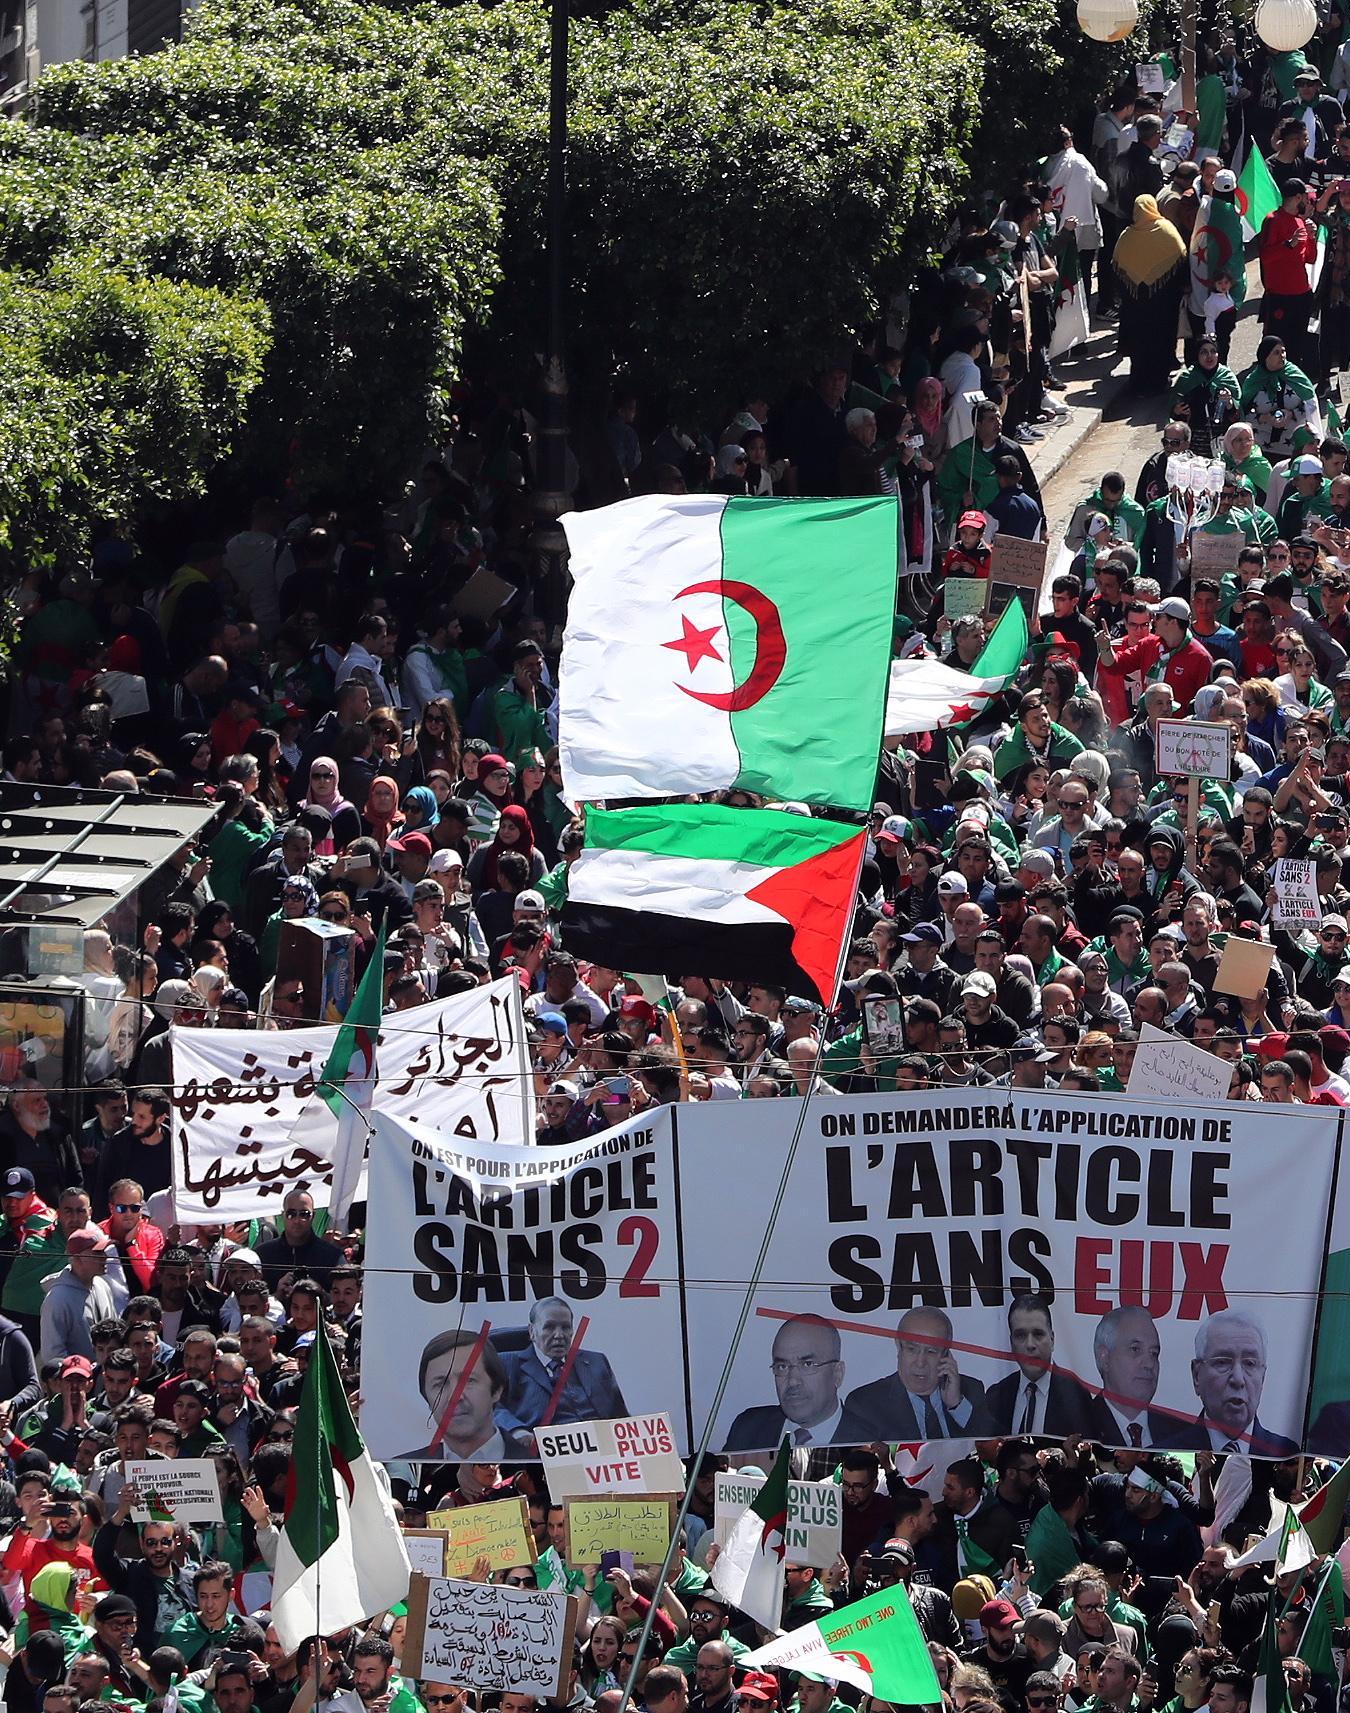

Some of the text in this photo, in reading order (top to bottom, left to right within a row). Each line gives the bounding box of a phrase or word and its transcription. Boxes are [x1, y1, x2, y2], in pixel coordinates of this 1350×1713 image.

[1280, 870, 1311, 885] SANS 2
[1280, 909, 1301, 918] SANS
[821, 1105, 1232, 1143] ON DEMANDERA L'APPLICATION DE
[411, 1128, 655, 1178] ON EST POUR L'APPLICATION DE
[412, 1151, 659, 1230] L'ARTICLE
[826, 1138, 1232, 1230] L'ARTICLE
[412, 1215, 661, 1304] SANS 2
[827, 1228, 1231, 1321] SANS EUX
[613, 1417, 669, 1441] ON VA
[542, 1431, 599, 1458] SEUL
[617, 1435, 673, 1458] PLUS
[159, 1473, 169, 1481] EST
[170, 1472, 178, 1480] LA
[179, 1471, 201, 1480] SOURCE
[585, 1461, 641, 1484] VITE
[718, 1484, 761, 1506] ENSEMB
[787, 1485, 838, 1508] ON VA
[787, 1504, 839, 1527] PLUS
[786, 1528, 808, 1548] IN
